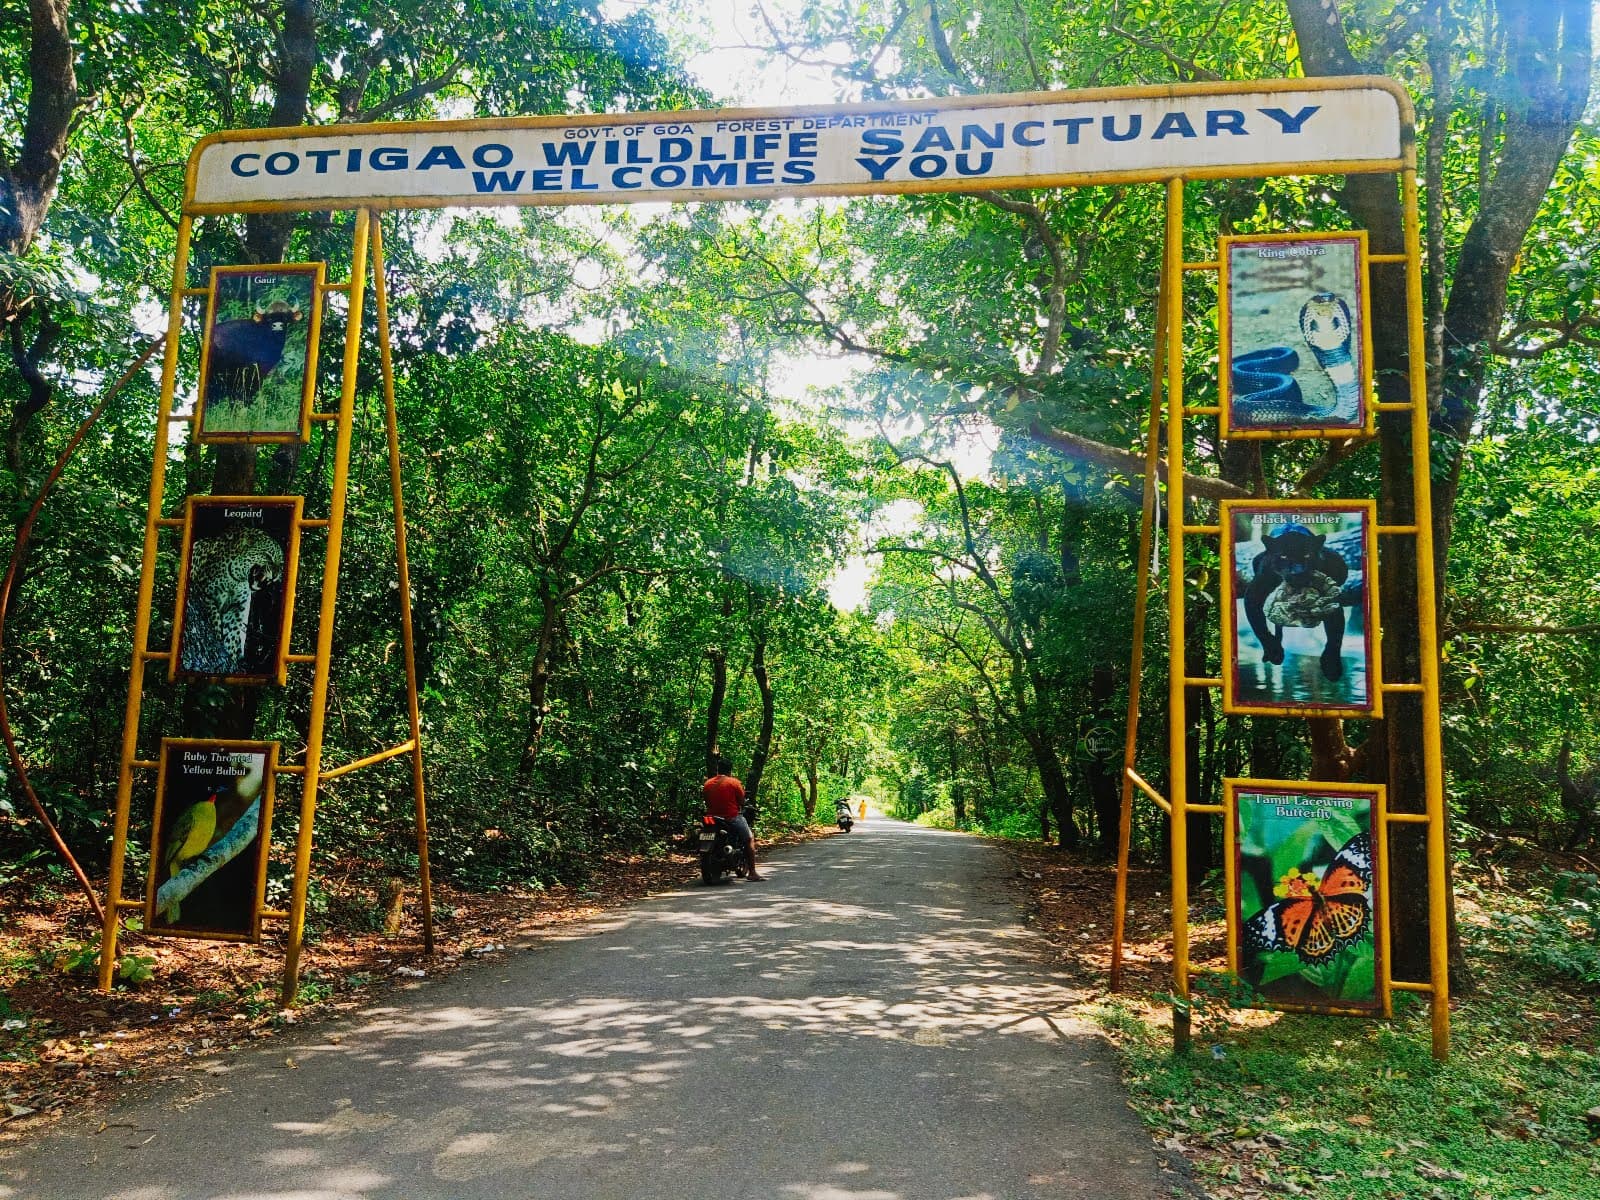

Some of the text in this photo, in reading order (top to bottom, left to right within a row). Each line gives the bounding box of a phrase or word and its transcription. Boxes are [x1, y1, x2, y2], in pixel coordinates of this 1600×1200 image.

[564, 112, 937, 140] GOVT. OF GOA FOREST DEPARTMENT
[231, 105, 1322, 178] COTIGAO WILDLIFE SANCTUARY
[472, 151, 995, 193] WELCOMES YOU
[1258, 246, 1326, 259] King Cobra
[254, 276, 276, 285] Gaur
[224, 508, 263, 519] Leopard
[1253, 513, 1341, 525] Black Panther
[183, 751, 253, 763] Ruby Throated
[183, 764, 246, 776] Yellow Bulbul
[1256, 793, 1354, 810] Tamil Lacewing
[1276, 805, 1332, 821] Butterfly
